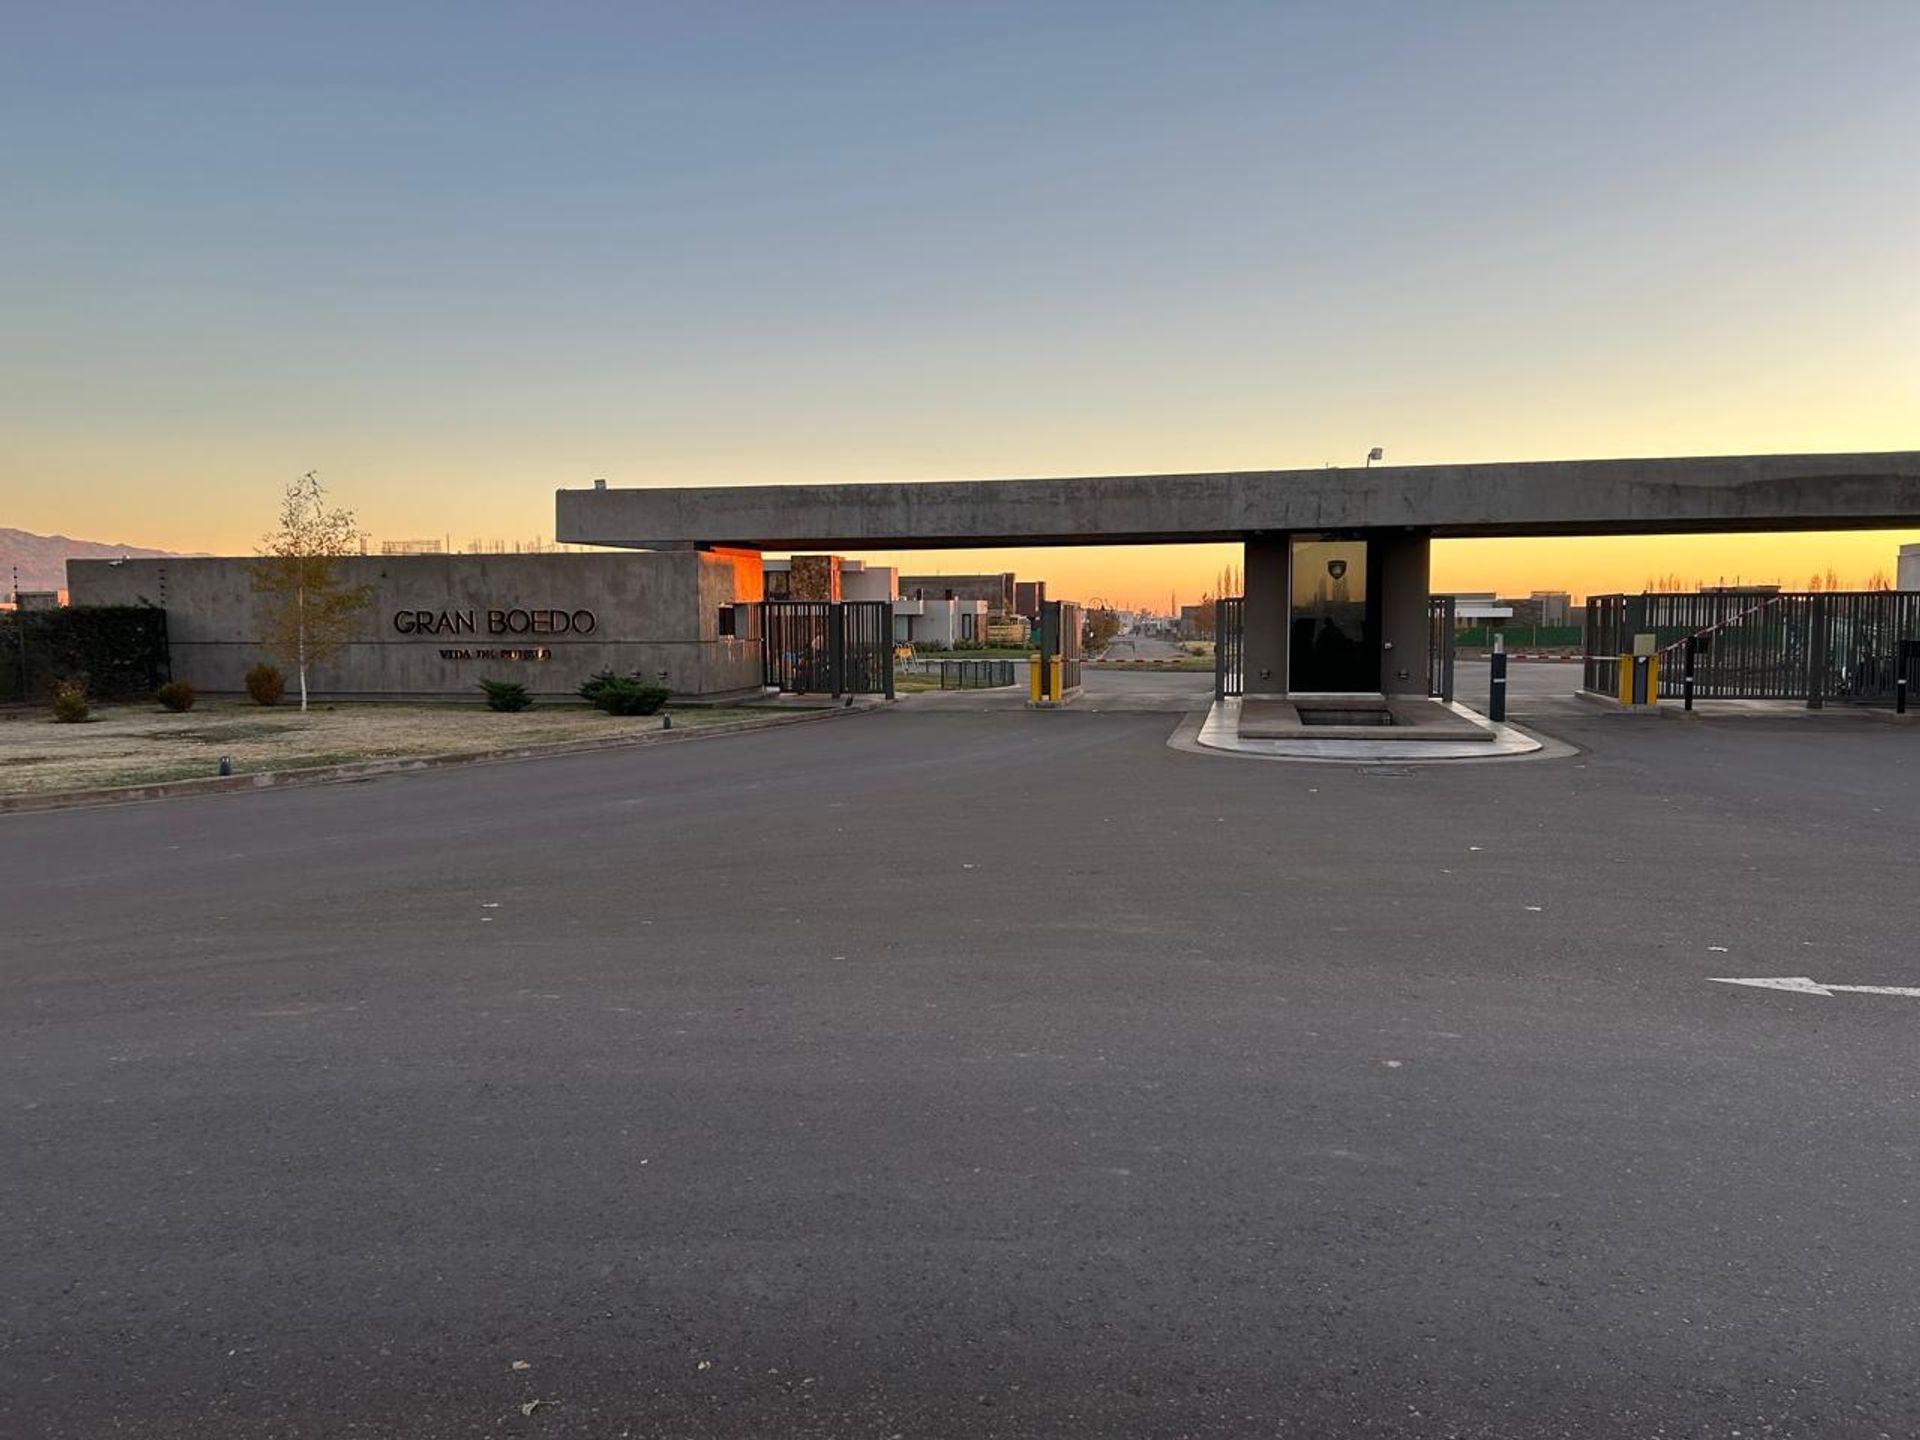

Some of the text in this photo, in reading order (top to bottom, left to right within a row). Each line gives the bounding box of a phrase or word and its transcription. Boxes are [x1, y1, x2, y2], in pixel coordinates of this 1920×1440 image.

[394, 609, 597, 634] GRAN BOEDO
[439, 649, 471, 660] VIDA
